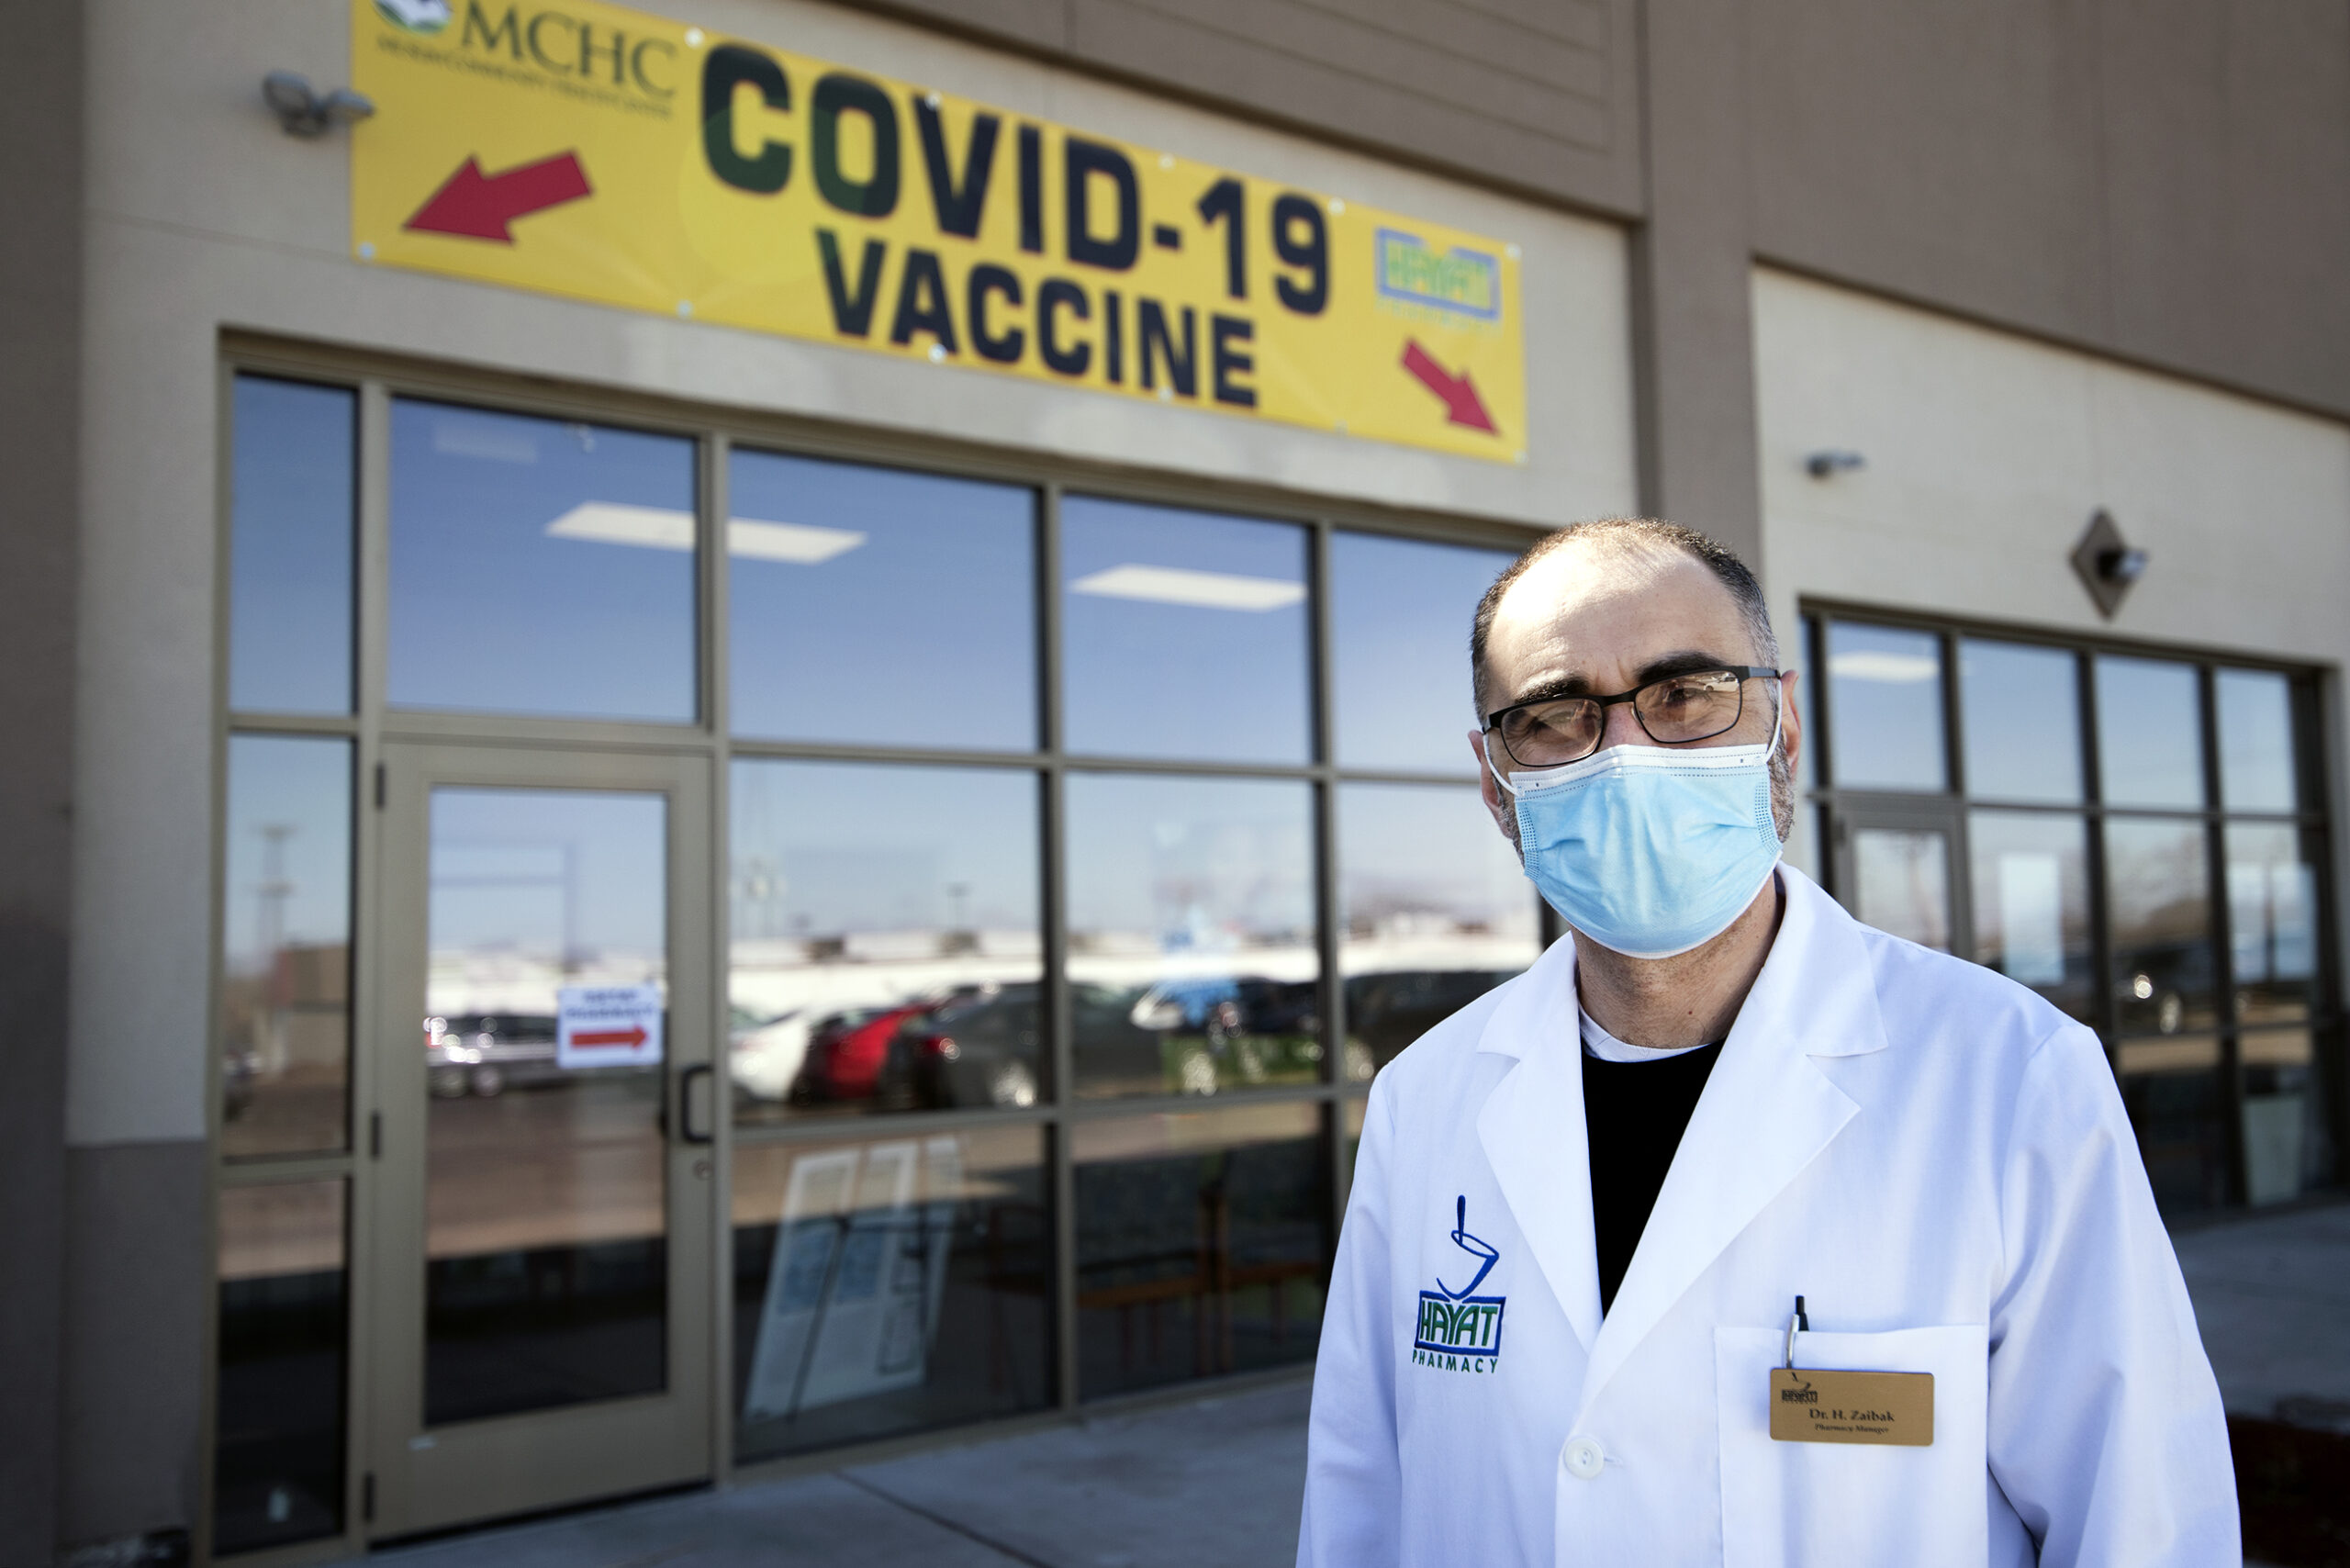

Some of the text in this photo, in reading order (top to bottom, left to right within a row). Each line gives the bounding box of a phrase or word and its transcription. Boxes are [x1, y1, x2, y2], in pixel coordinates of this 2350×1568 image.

[461, 0, 678, 98] MCHC
[700, 42, 1330, 318] COVID-19
[813, 226, 1258, 409] VACCINE
[1419, 1300, 1498, 1347] HAYAT
[1412, 1349, 1498, 1373] PHARMACY
[1809, 1408, 1895, 1422] Dr. H. Zaibak
[1815, 1423, 1889, 1434] Pharmacy Manager
